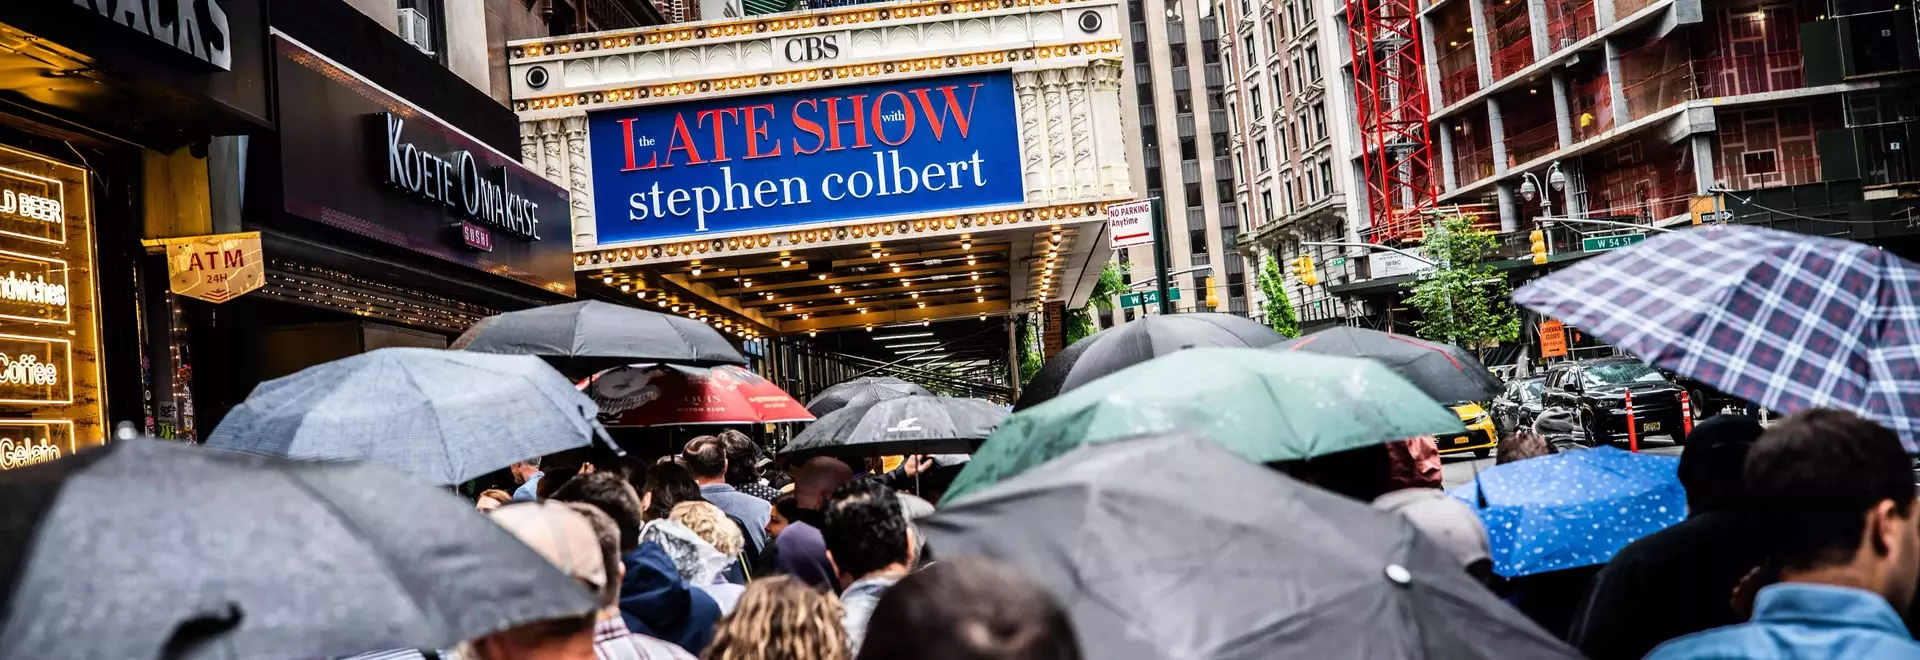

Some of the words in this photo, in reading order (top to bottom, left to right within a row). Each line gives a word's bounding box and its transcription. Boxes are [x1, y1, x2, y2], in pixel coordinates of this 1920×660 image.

[73, 0, 232, 71] ACKS
[784, 34, 839, 62] CBS
[616, 103, 781, 172] LATE
[792, 83, 985, 156] SHOW
[881, 109, 905, 124] with
[638, 134, 656, 148] the
[387, 112, 456, 207] KOETE
[629, 165, 811, 232] stephen
[821, 149, 988, 201] colbert
[19, 192, 62, 224] BEER
[1110, 209, 1120, 218] NO
[1120, 204, 1149, 216] PARKING
[1111, 217, 1139, 228] Anytime
[464, 226, 489, 247] SUSHI
[1597, 240, 1606, 248] W
[1609, 238, 1620, 247] 54
[1622, 236, 1632, 246] St
[189, 249, 244, 271] ATM
[206, 274, 228, 284] 24H
[1130, 296, 1139, 304] W
[1142, 292, 1156, 302] 54
[0, 353, 57, 385] Coffee
[0, 438, 61, 470] Gelato
